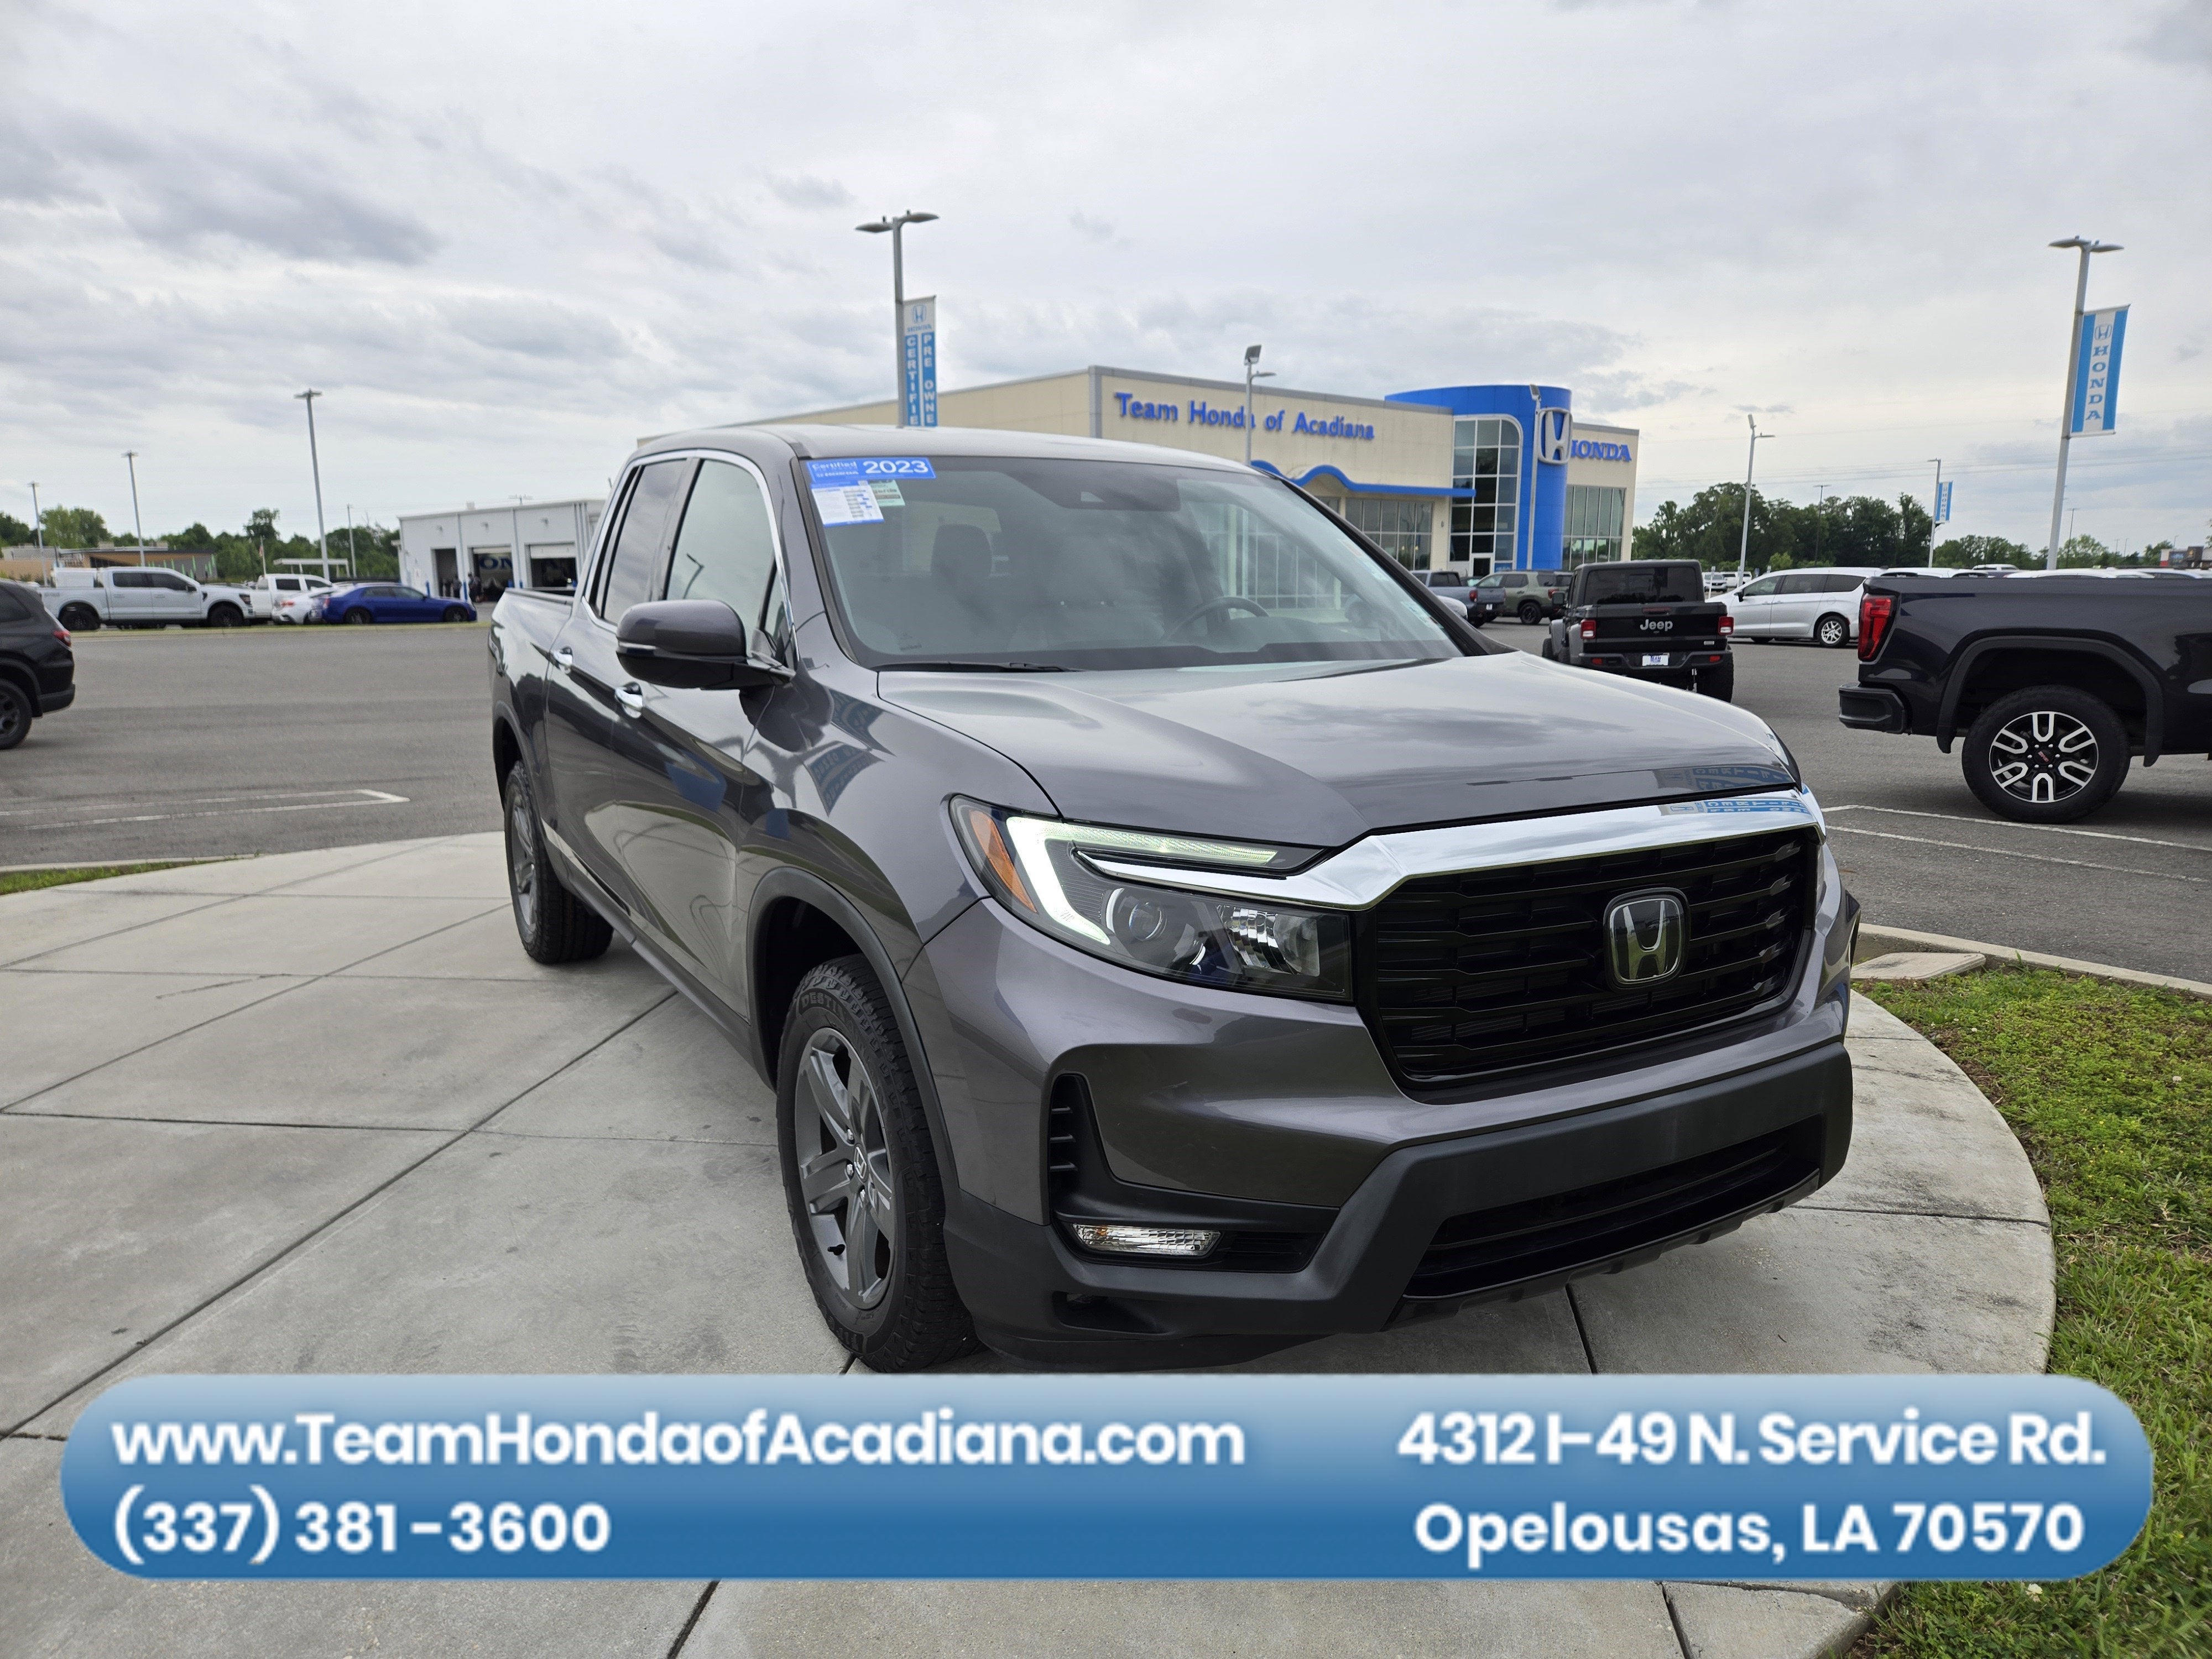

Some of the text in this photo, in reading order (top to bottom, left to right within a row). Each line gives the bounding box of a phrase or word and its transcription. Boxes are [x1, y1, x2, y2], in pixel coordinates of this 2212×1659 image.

[924, 334, 932, 367] PRE
[2085, 345, 2109, 420] HONDA
[1115, 392, 1178, 421] Team
[1265, 409, 1285, 431] of
[1293, 411, 1375, 440] Acadiana
[812, 460, 929, 474] Certified 2023
[1640, 619, 1673, 632] Jeep
